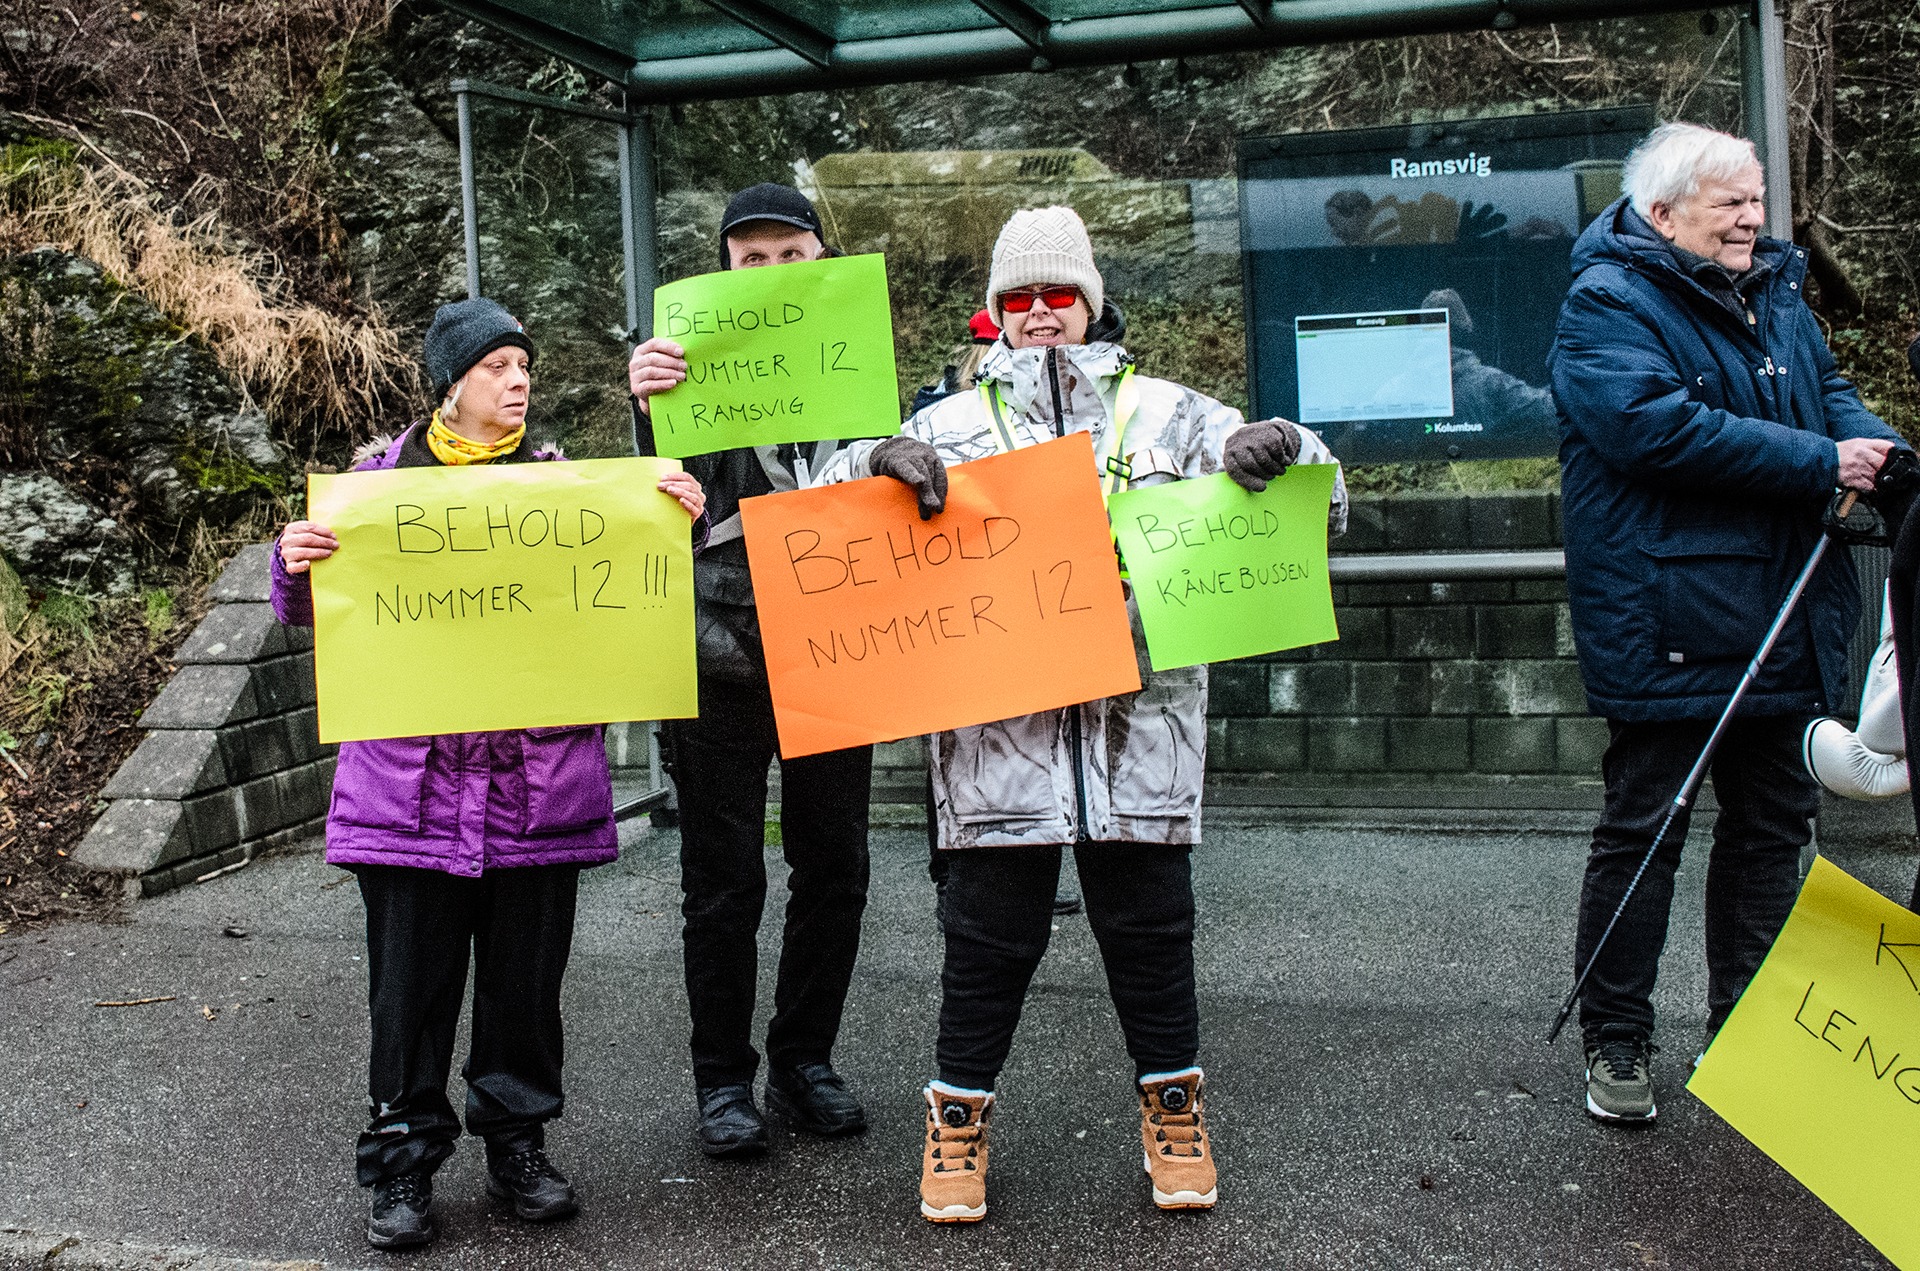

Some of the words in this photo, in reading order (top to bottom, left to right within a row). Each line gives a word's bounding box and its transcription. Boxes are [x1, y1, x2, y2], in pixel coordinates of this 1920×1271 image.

[1390, 152, 1492, 178] Ramsvig
[665, 302, 804, 338] BEHOLD
[684, 354, 791, 385] UMMER
[821, 341, 859, 375] 12
[691, 396, 804, 430] RAMSVIG
[1434, 422, 1483, 433] Kolumbus
[395, 504, 606, 554] BEHOLD
[1135, 509, 1279, 554] BEHOLD
[784, 516, 1022, 595] BEHOLD
[376, 583, 532, 626] NUMMER
[807, 595, 1008, 669] NUMMER
[1031, 560, 1093, 620] 12
[1875, 922, 1920, 996] K
